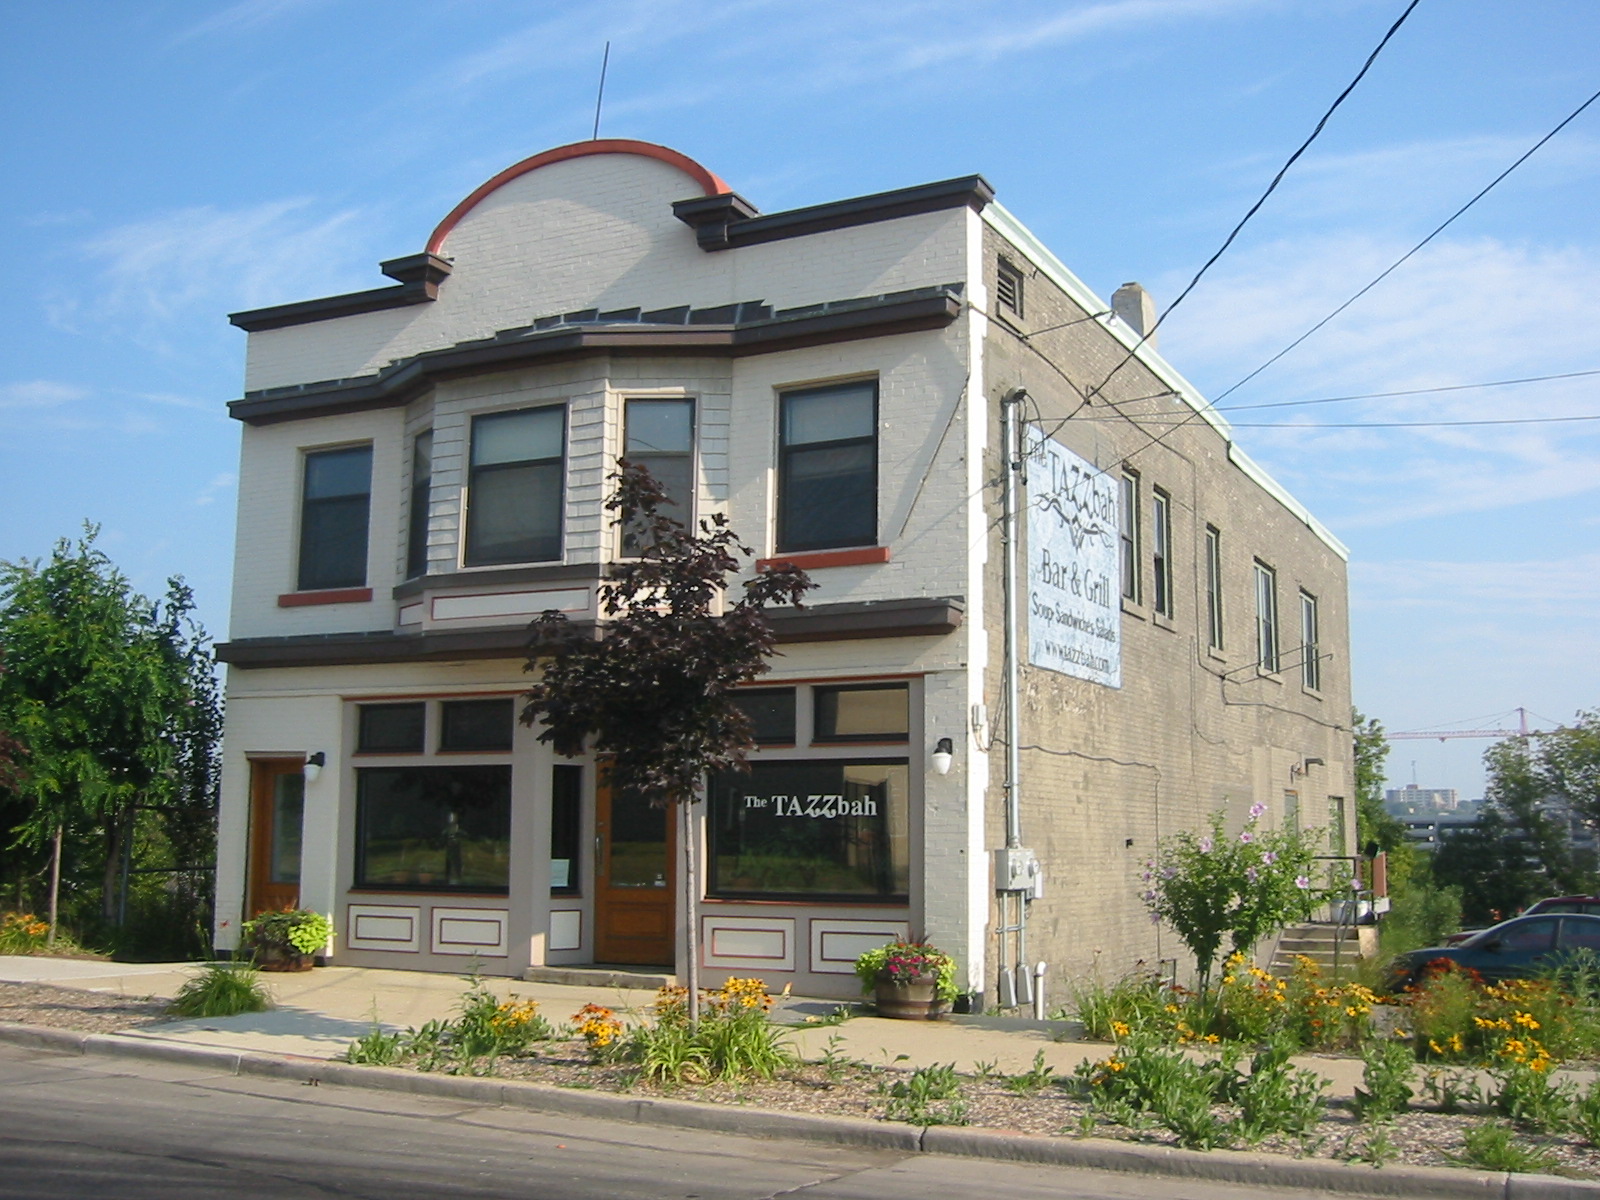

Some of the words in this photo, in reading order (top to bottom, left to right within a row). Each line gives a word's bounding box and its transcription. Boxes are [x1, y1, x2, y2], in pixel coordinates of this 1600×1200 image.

[1047, 450, 1117, 528] TAZZbah
[1042, 548, 1067, 591] Bar
[1070, 561, 1082, 598] &
[1084, 569, 1110, 609] Grill
[1031, 591, 1055, 628] Soup
[744, 796, 767, 808] The
[771, 795, 877, 818] TAZZbah
